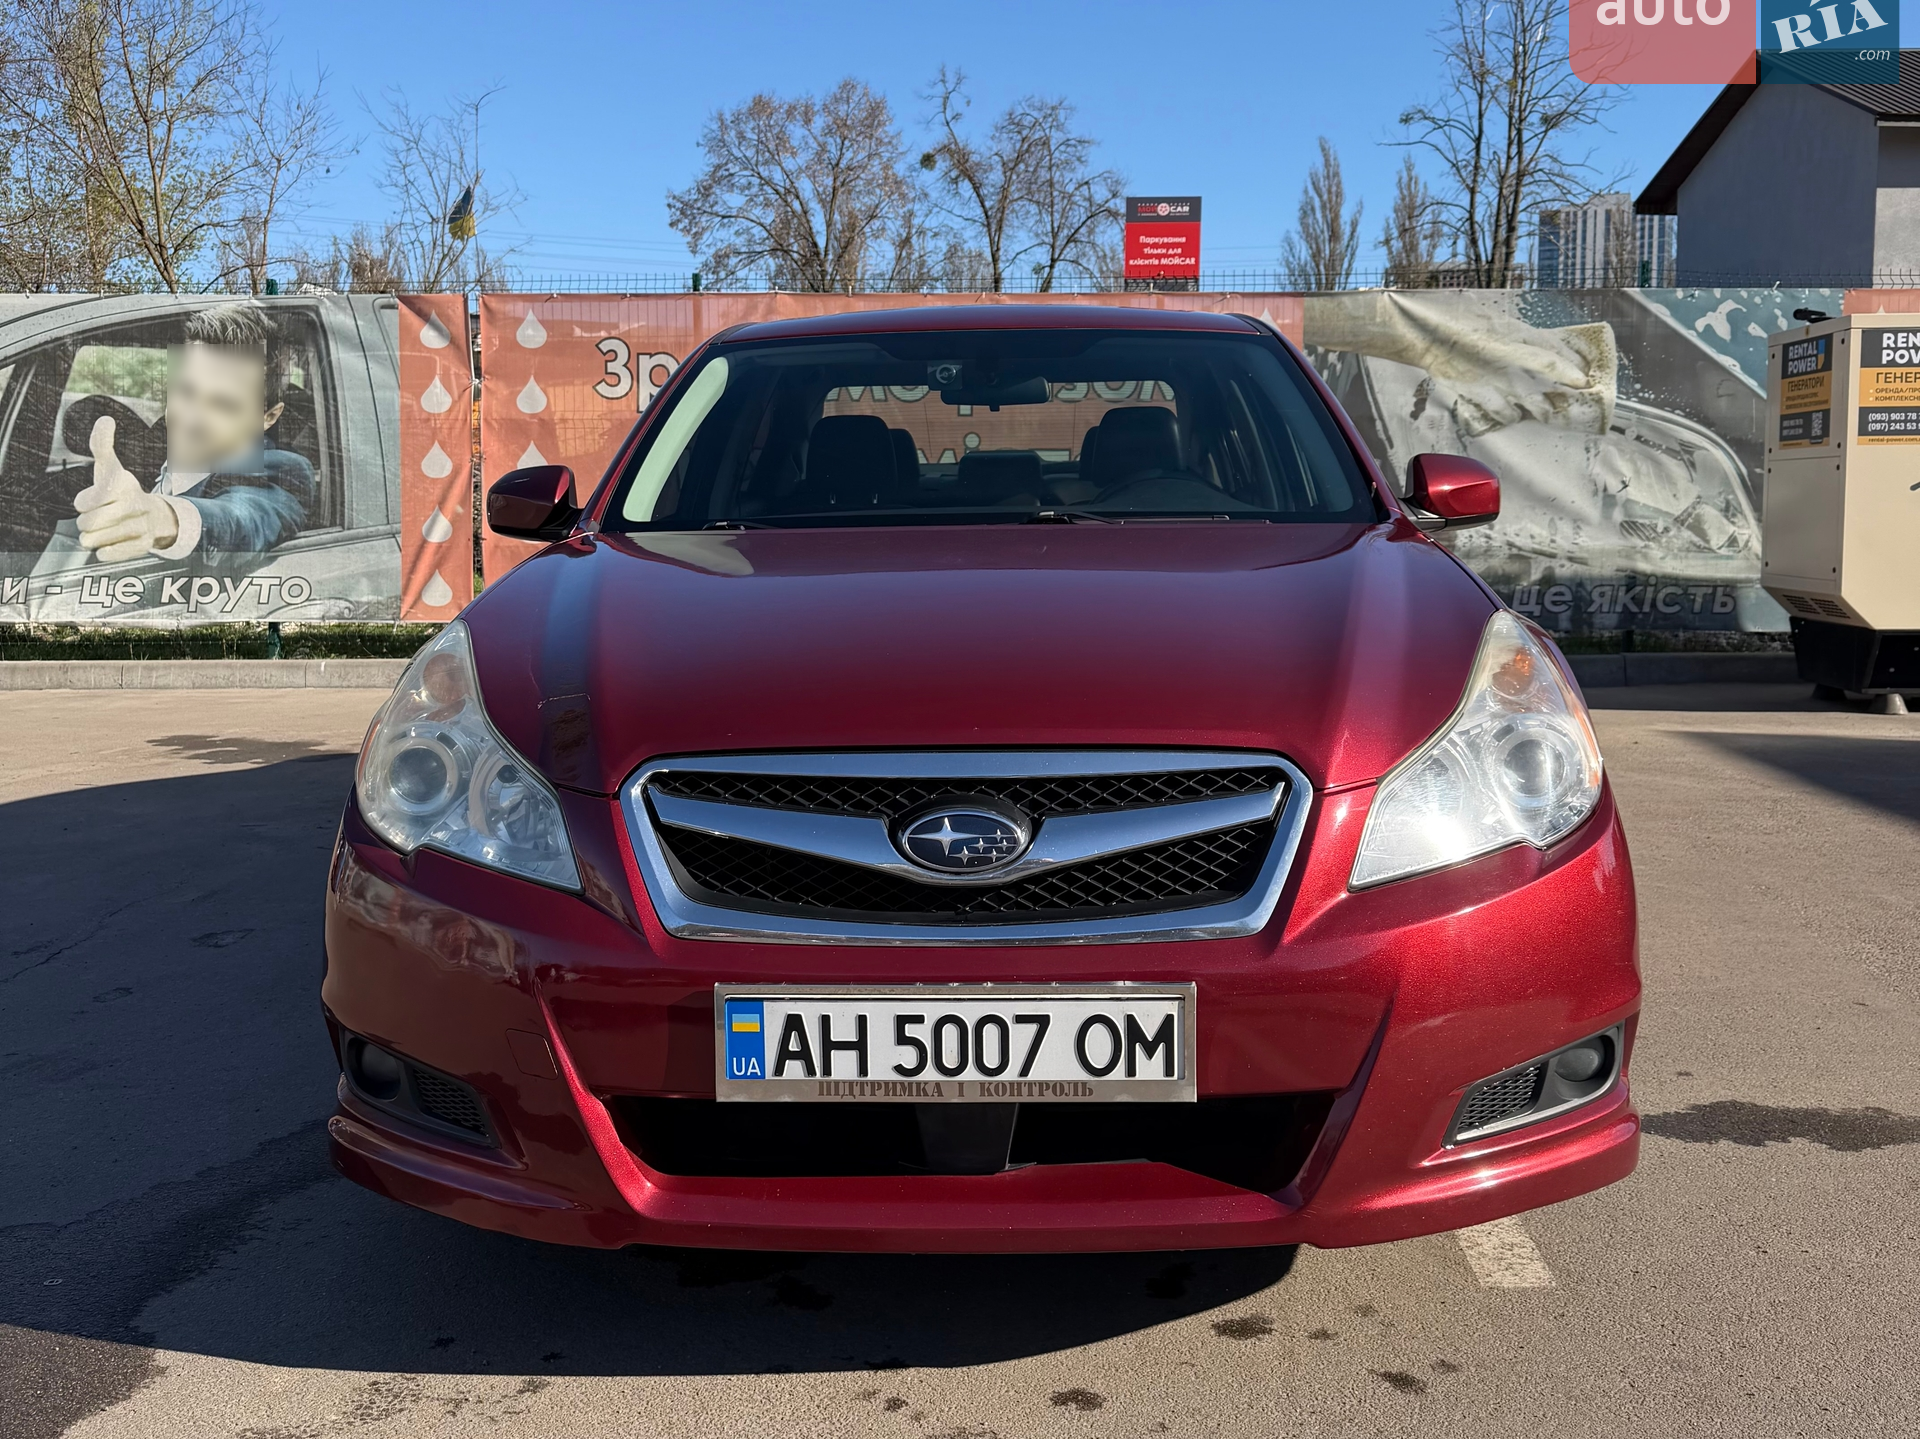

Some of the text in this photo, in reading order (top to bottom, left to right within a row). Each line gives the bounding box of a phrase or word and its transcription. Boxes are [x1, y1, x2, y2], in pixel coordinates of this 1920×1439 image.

[1139, 235, 1187, 245] Паркування
[1143, 246, 1182, 255] тільки для
[1129, 257, 1159, 265] клієнтів
[1789, 341, 1817, 360] RENTAL
[592, 336, 682, 414] Зр
[1788, 357, 1816, 375] POWER
[1788, 376, 1824, 392] ГЕНЕРАТОРИ
[1868, 412, 1918, 422] (093) 903 78
[1889, 422, 1905, 431] 243
[78, 575, 146, 608] це
[160, 575, 313, 614] круто
[1511, 575, 1738, 618] це якість
[773, 1012, 1176, 1078] AH 5007 OM
[732, 1057, 762, 1077] UA
[818, 1081, 944, 1099] ПІДТРИМКА
[979, 1081, 1094, 1097] КОНТРОЛЬ
